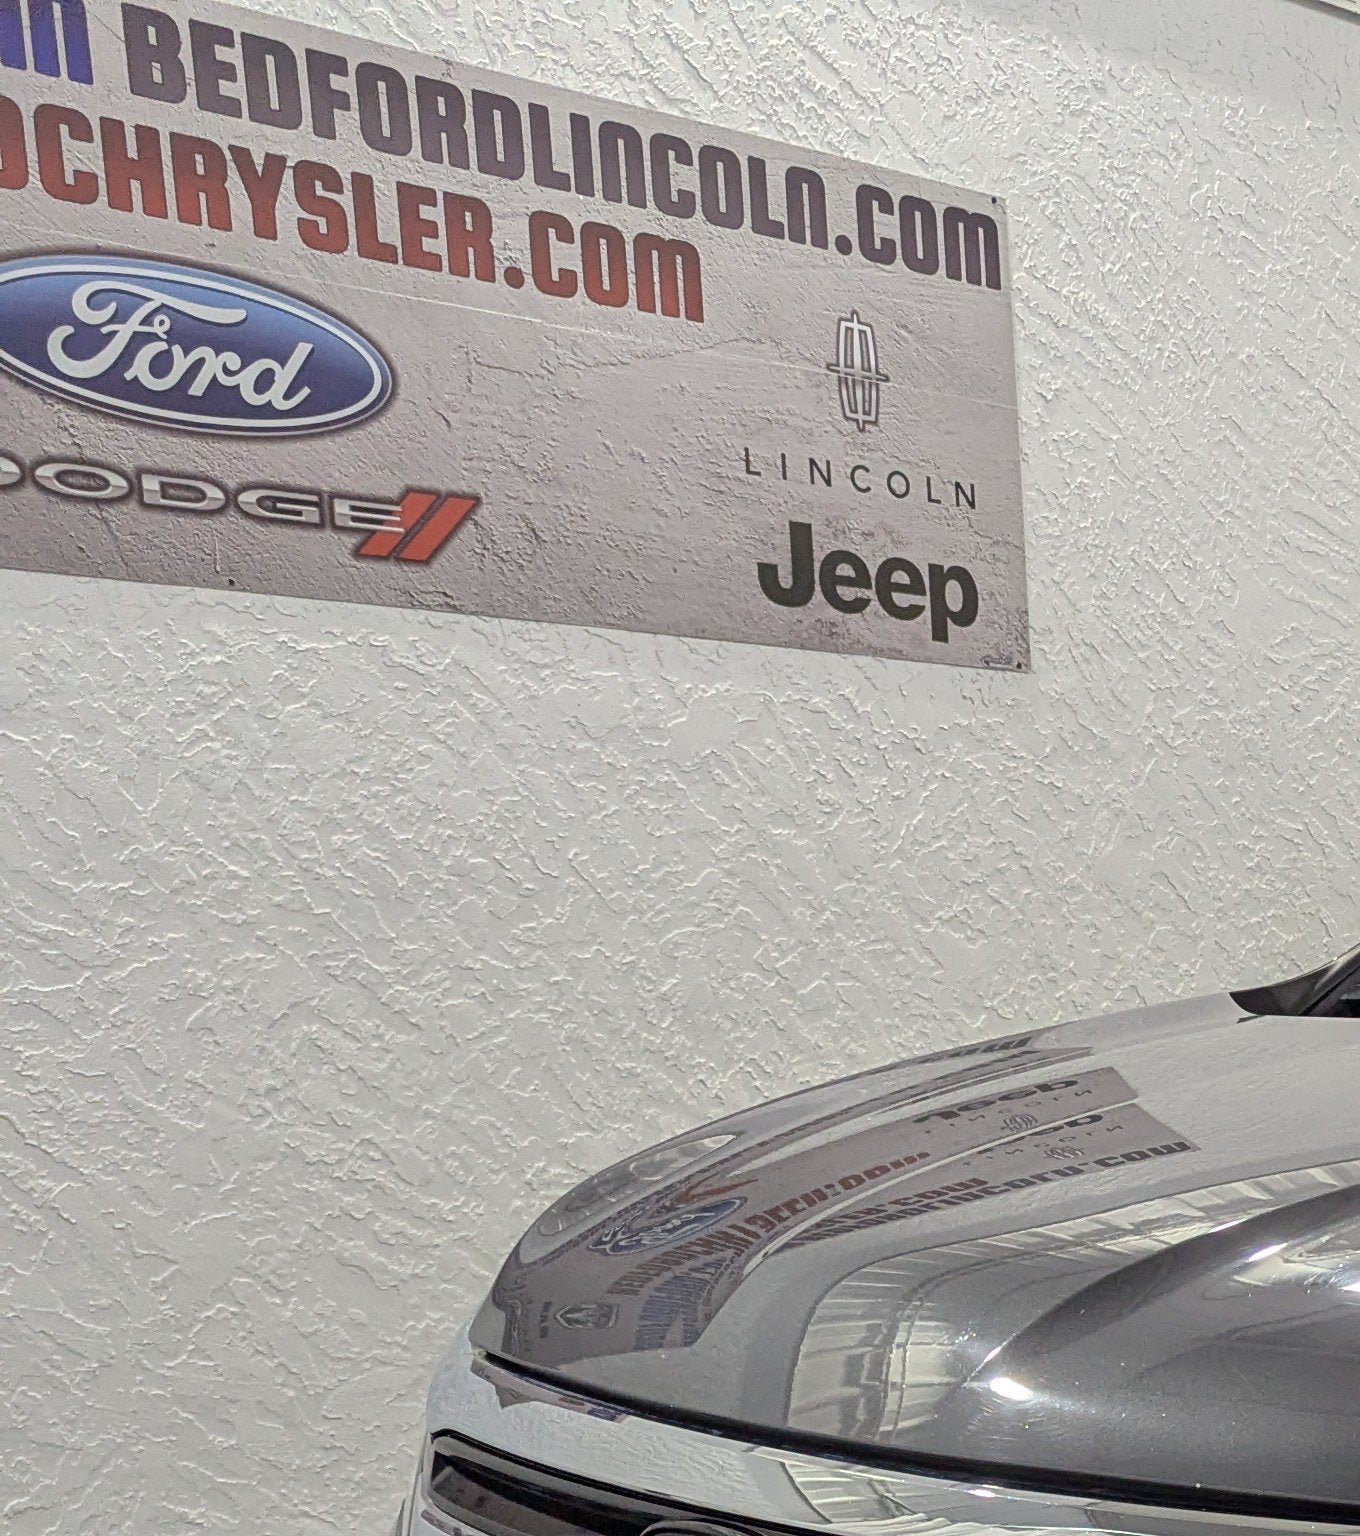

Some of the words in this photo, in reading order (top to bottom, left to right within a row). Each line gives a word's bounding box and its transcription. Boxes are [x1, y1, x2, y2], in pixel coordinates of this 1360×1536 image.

[121, 3, 1002, 291] BEDFORDLINCOLN.COM
[47, 280, 314, 411] Ford
[0, 458, 405, 533] ODGE
[744, 447, 976, 510] LINCOLN
[757, 519, 979, 643] Jeep
